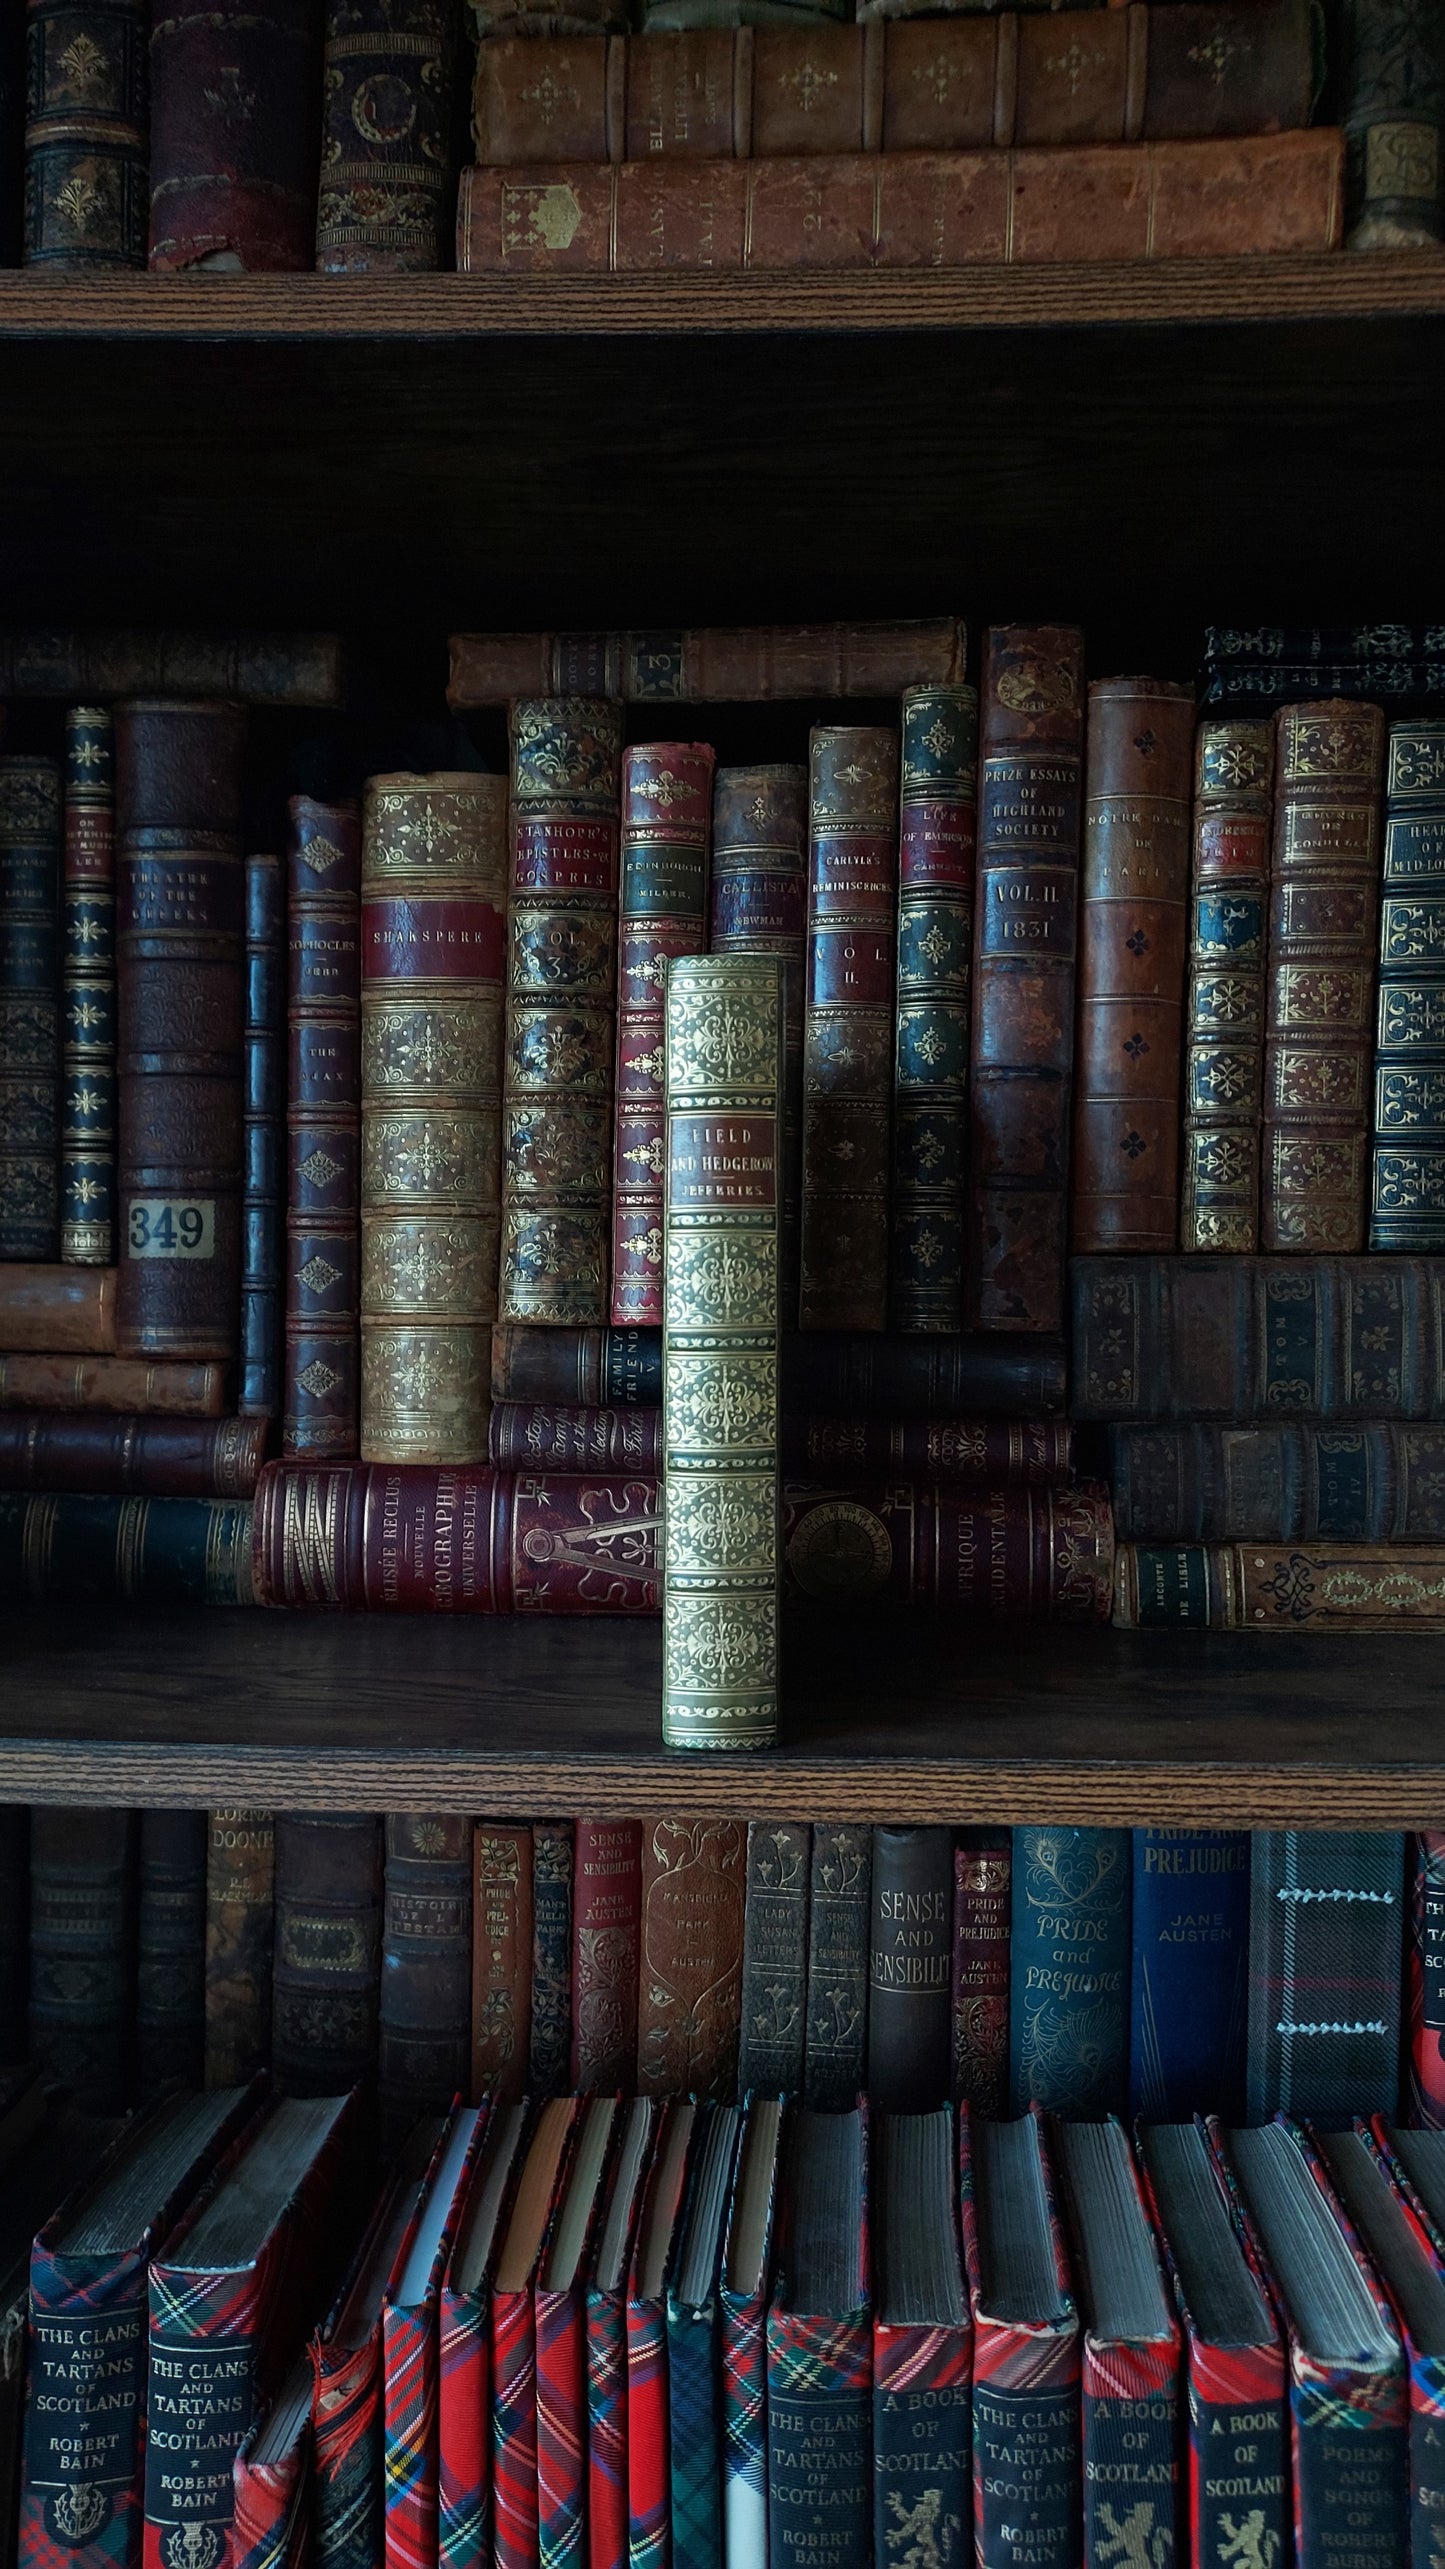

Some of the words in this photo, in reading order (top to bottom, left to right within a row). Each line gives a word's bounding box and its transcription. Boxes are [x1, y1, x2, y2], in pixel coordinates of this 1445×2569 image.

[985, 770, 1023, 782] PRIZE
[1030, 770, 1076, 781] ESSAYS
[1021, 788, 1038, 798] OF
[993, 805, 1065, 818] HIGHLAND
[79, 819, 95, 827] ON
[1088, 813, 1140, 826] NOTRE
[518, 826, 608, 843] STANHOPE'S
[904, 833, 916, 841] OF
[996, 825, 1059, 836] SOCIETY
[1136, 839, 1152, 848] DE
[1422, 842, 1443, 853] OF
[826, 852, 880, 865] CARLYLE'S
[130, 873, 208, 884] THEATRE
[517, 871, 603, 885] GOSPELS
[722, 881, 797, 894] CALLISTA
[139, 890, 156, 900] OF
[166, 890, 196, 901] THE
[132, 909, 208, 921] GREEKS
[734, 916, 784, 925] NEWMAN
[1003, 921, 1049, 938] 1831
[373, 931, 483, 944] SHAKSPERE
[532, 931, 586, 945] VOL.
[289, 940, 355, 950] SOPHOCLES
[309, 1049, 336, 1057] THE
[693, 1128, 751, 1143] FIELD
[671, 1156, 696, 1171] AND
[702, 1156, 773, 1171] HEDGEROW
[130, 1206, 203, 1248] 349
[612, 1334, 624, 1396] FAMILY
[627, 1331, 639, 1401] FRIEND
[383, 1476, 401, 1539] RECLUS
[415, 1505, 425, 1579] NOUVELLE
[429, 1473, 457, 1608] GÉOGRAPHIE
[462, 1485, 477, 1597] UNIVERSELLE
[378, 1547, 399, 1601] ÉLISÉE
[1177, 1553, 1189, 1589] LISLE
[1155, 1563, 1165, 1606] LECONTE
[1179, 1600, 1189, 1616] DE
[589, 1832, 632, 1846] SENSE
[597, 1850, 623, 1860] AND
[1144, 1845, 1246, 1874] PREJUDICE
[584, 1859, 635, 1875] SENSIBILITY
[486, 1888, 510, 1899] PRIDE
[592, 1895, 624, 1906] JANE
[663, 1893, 727, 1903] MANSFIELD
[880, 1890, 945, 1922] SENSE
[967, 1898, 1005, 1910] PRIDE
[585, 1906, 632, 1920] AUSTEN
[764, 1909, 792, 1919] LADY
[827, 1912, 853, 1922] SENSE
[974, 1914, 998, 1924] AND
[1170, 1913, 1224, 1927] JANE
[677, 1920, 710, 1929] PARK
[1036, 1915, 1108, 1941] PRIDE
[761, 1927, 798, 1938] SUSAN
[830, 1932, 849, 1941] AND
[895, 1930, 934, 1947] AND
[959, 1927, 1009, 1940] PREJUDICE
[1158, 1928, 1233, 1942] AUSTEN
[818, 1948, 859, 1960] SENSIBILITY
[1052, 1947, 1094, 1964] and
[671, 1958, 714, 1967] AUSTEN
[968, 1961, 1000, 1970] JANE
[960, 1973, 1009, 1984] AUSTEN
[1025, 1966, 1122, 2000] PREJUDICE
[37, 2328, 74, 2345] THE
[79, 2322, 141, 2345] CLANS
[71, 2350, 105, 2360] AND
[42, 2357, 134, 2380] TARTANS
[152, 2357, 183, 2379] THE
[189, 2360, 250, 2379] CLANS
[75, 2383, 97, 2395] OF
[179, 2383, 214, 2394] AND
[36, 2392, 137, 2413] SCOTLAND
[154, 2394, 243, 2415] TARTANS
[881, 2393, 901, 2411] A
[907, 2387, 968, 2410] BOOK
[979, 2403, 1017, 2428] THE
[1094, 2402, 1111, 2419] A
[186, 2418, 206, 2430] OF
[770, 2411, 804, 2431] THE
[1209, 2417, 1225, 2436] A
[1230, 2411, 1280, 2434] BOOK
[911, 2421, 940, 2438] OF
[50, 2433, 120, 2452] ROBERT
[801, 2437, 835, 2448] AND
[1015, 2432, 1049, 2444] AND
[1122, 2432, 1150, 2449] OF
[1424, 2427, 1441, 2447] A
[773, 2449, 864, 2469] TARTANS
[985, 2441, 1076, 2466] TARTANS
[1234, 2445, 1259, 2464] OF
[1322, 2447, 1394, 2462] POEMS
[60, 2453, 105, 2469] BAIN
[160, 2473, 230, 2489] ROBERT
[808, 2473, 829, 2485] OF
[1022, 2469, 1043, 2481] OF
[1339, 2470, 1381, 2484] AND
[1206, 2475, 1286, 2497] SCOTLAND
[171, 2492, 218, 2508] BAIN
[1324, 2489, 1391, 2504] SONGS
[1347, 2512, 1375, 2526] OF
[783, 2530, 853, 2546] ROBERT
[1001, 2524, 1068, 2544] ROBERT
[1321, 2532, 1396, 2547] ROBERT
[795, 2550, 840, 2564] BAIN
[1012, 2547, 1056, 2563] BAIN
[1327, 2554, 1393, 2569] BURNS
